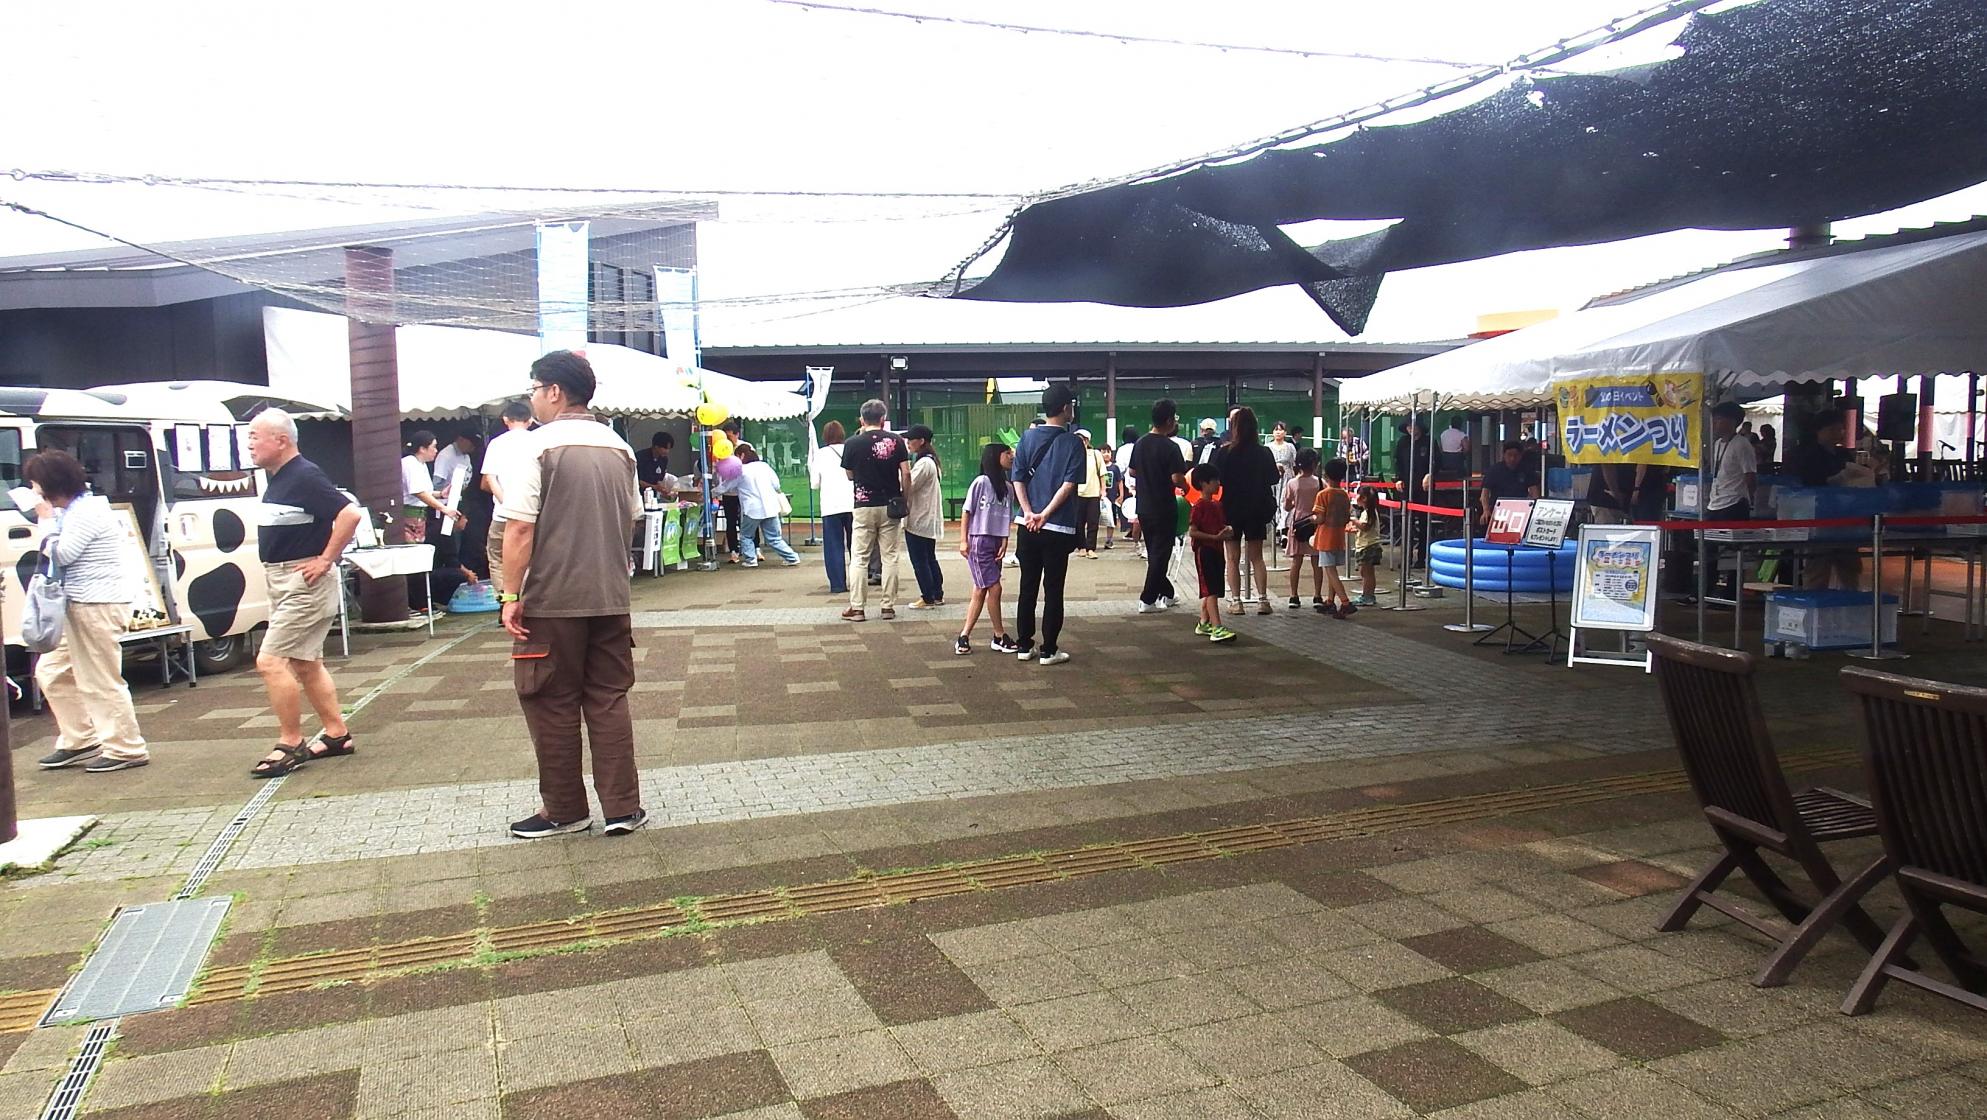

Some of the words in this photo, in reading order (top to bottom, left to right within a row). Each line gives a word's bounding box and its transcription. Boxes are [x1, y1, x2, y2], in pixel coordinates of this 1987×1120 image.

[1566, 412, 1689, 460] ラーメンつり
[1491, 508, 1526, 534] 出口
